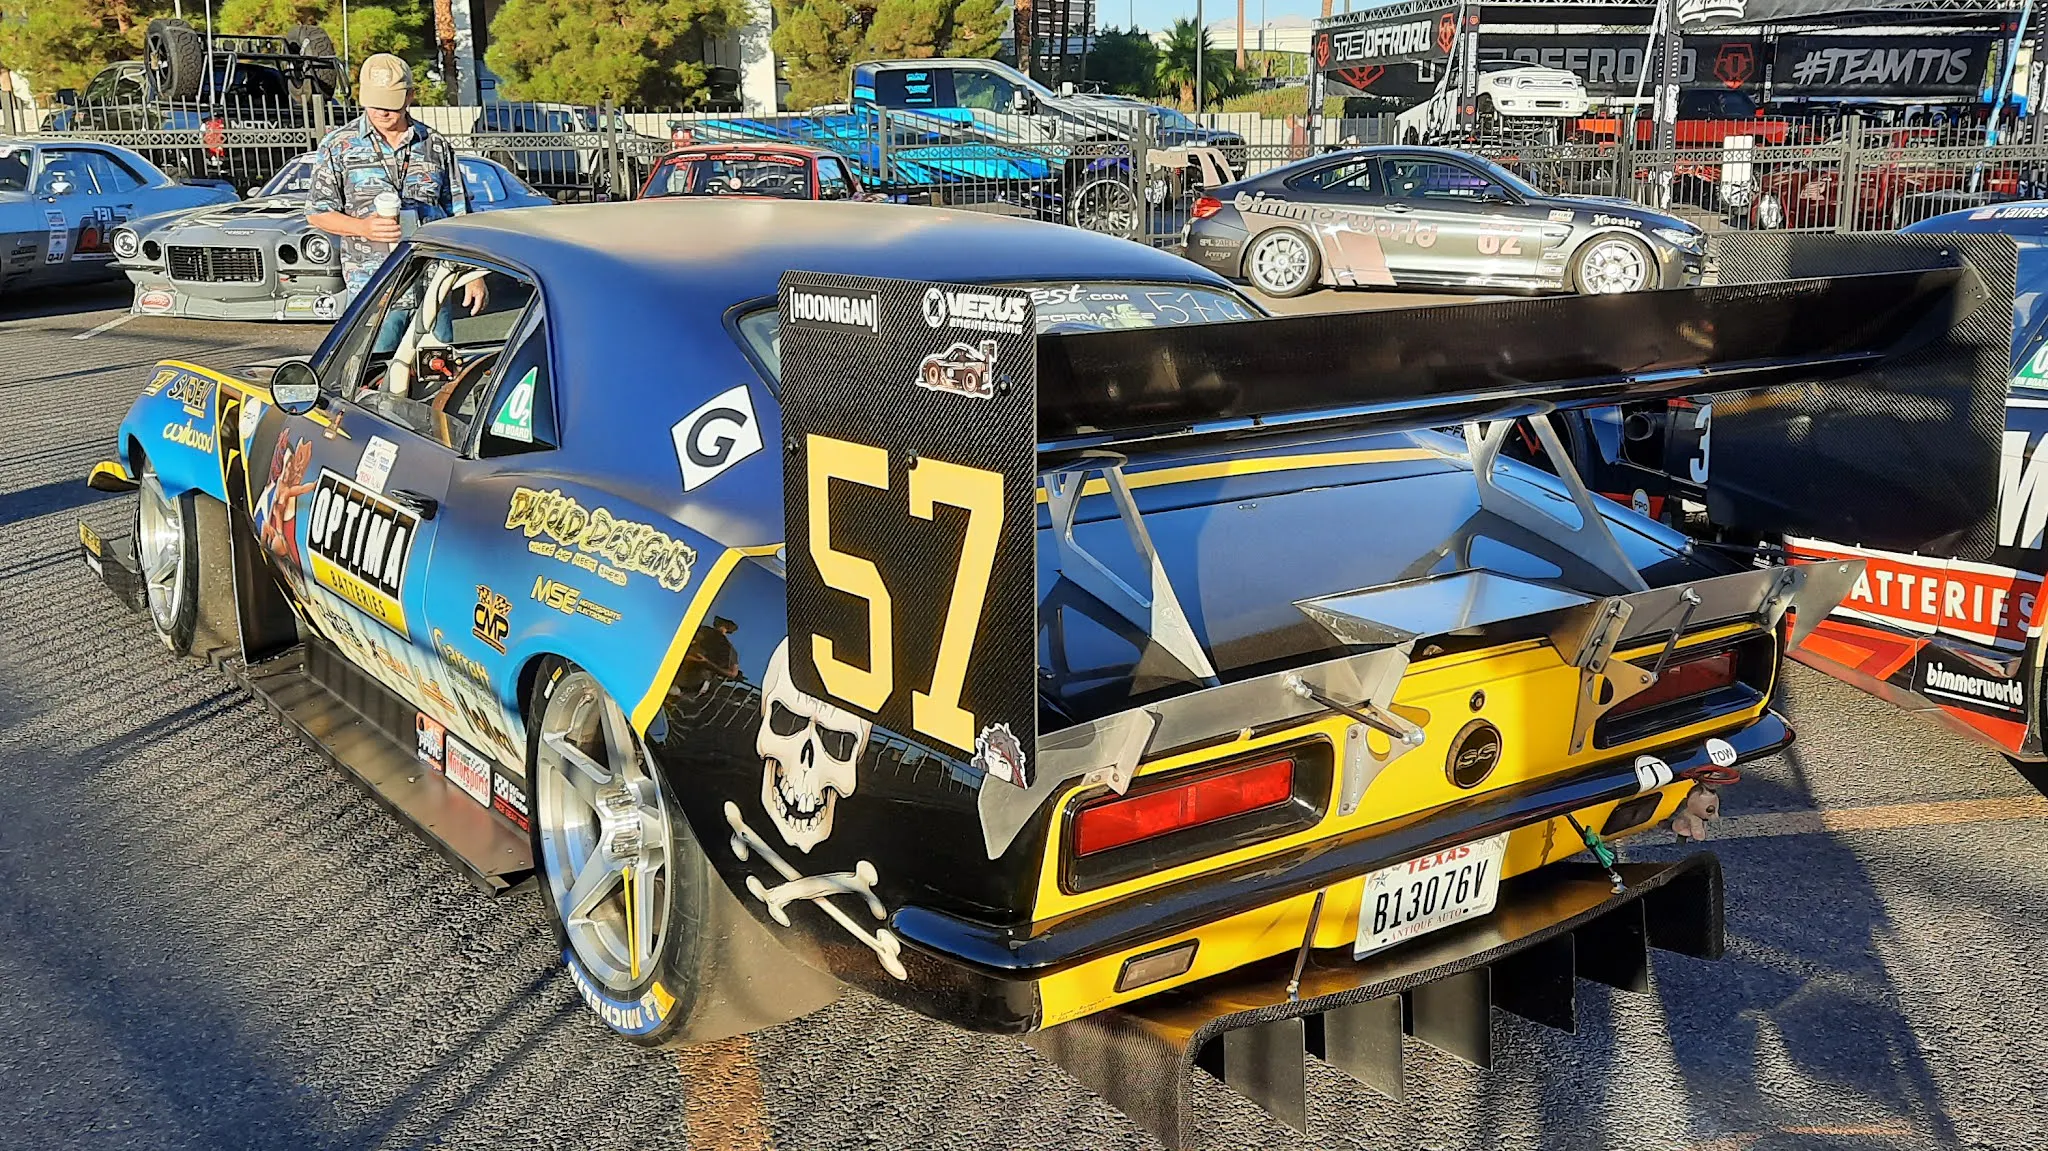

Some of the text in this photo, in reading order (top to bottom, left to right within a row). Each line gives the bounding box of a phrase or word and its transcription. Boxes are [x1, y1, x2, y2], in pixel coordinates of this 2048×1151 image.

[1792, 47, 1972, 86] #TEAMTIS
[1234, 191, 1438, 248] bimmerworld
[947, 292, 1027, 323] VERUS
[686, 407, 748, 468] G
[311, 487, 407, 590] OPTIMA
[329, 569, 387, 619] BATTERIES
[529, 574, 581, 616] MSE
[806, 433, 1005, 755] 57
[1850, 568, 2036, 633] ATTERIES
[474, 603, 509, 642] CMP
[1926, 662, 2024, 706] bimmerworld
[1640, 761, 1665, 786] T
[1711, 748, 1734, 763] TOW
[1407, 845, 1471, 875] TEXAS
[1372, 858, 1489, 936] B13076V
[1391, 907, 1463, 941] ANTIQUE AUTO
